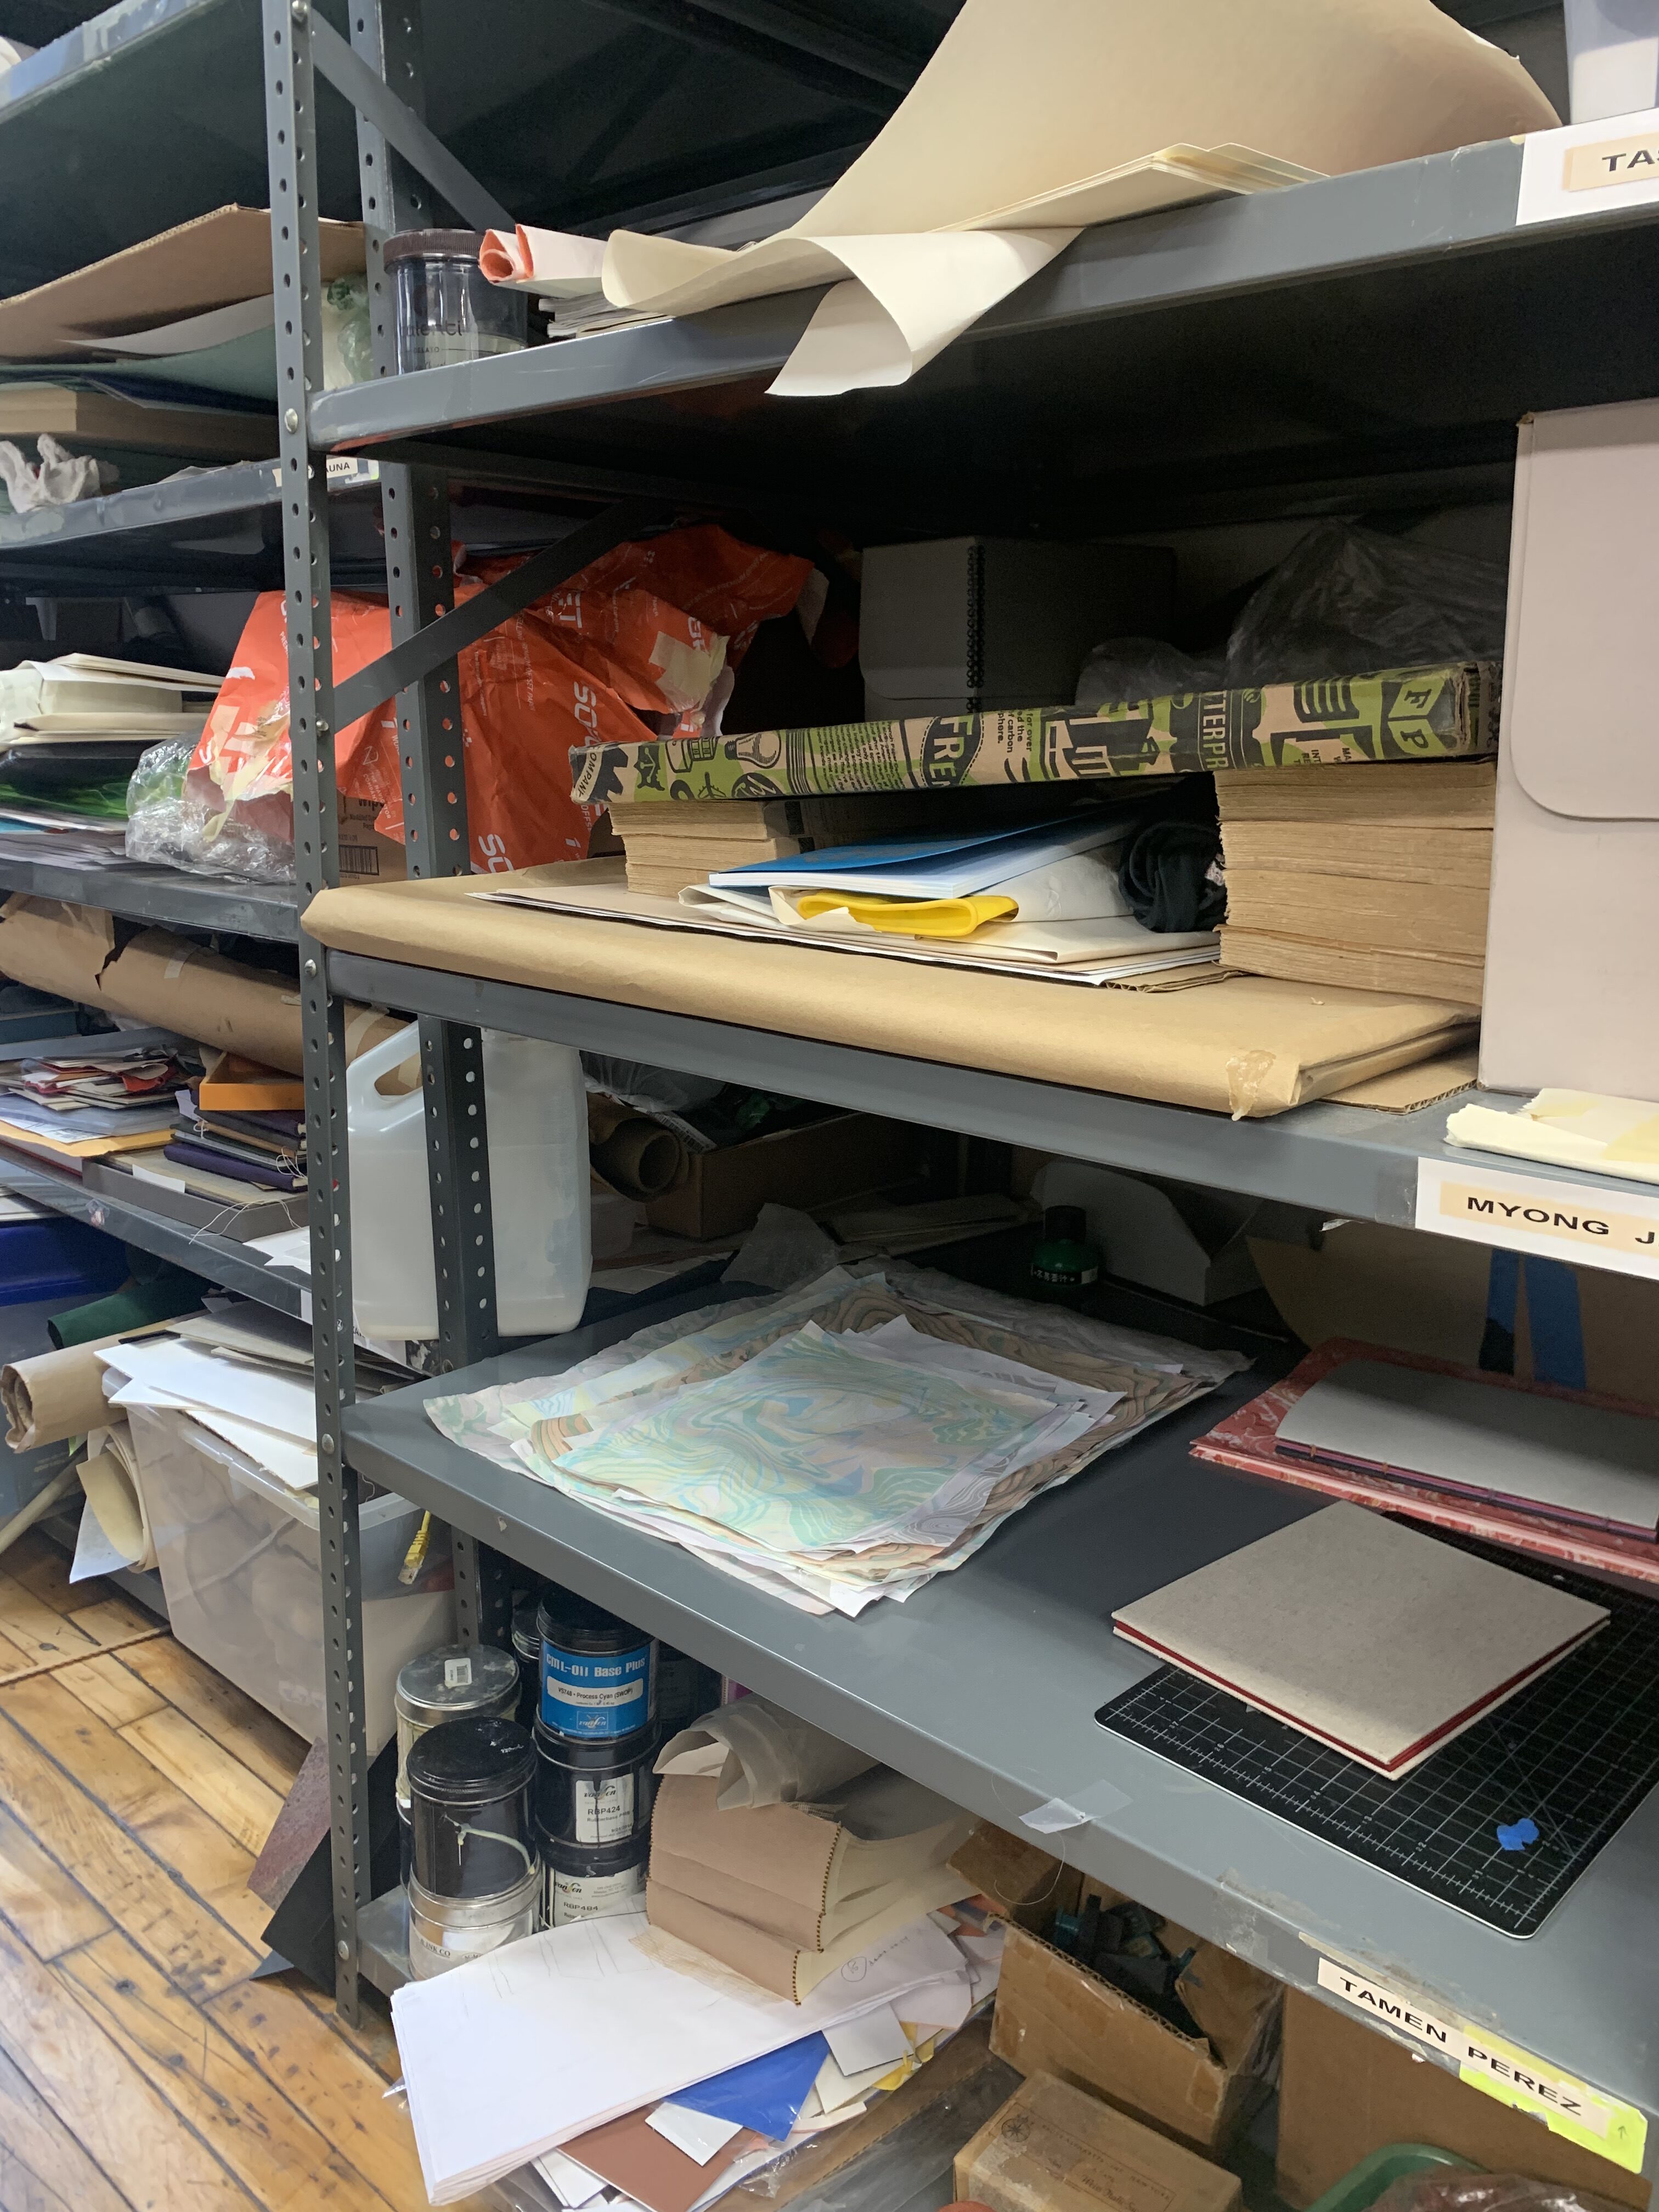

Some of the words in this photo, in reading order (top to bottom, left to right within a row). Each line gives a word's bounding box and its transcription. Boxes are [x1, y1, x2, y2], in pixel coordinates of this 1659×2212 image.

[578, 752, 597, 798] OMPANY
[1468, 1197, 1609, 1235] MYONG
[1635, 1232, 1658, 1244] J
[594, 1666, 622, 1677] Base
[625, 1657, 645, 1673] Plus
[614, 1688, 633, 1700] (SWOP)
[588, 1805, 620, 1815] RBP424
[426, 1942, 437, 1953] INK
[1340, 1976, 1447, 2044] TAMEN
[1468, 2046, 1582, 2117] PEREZ
